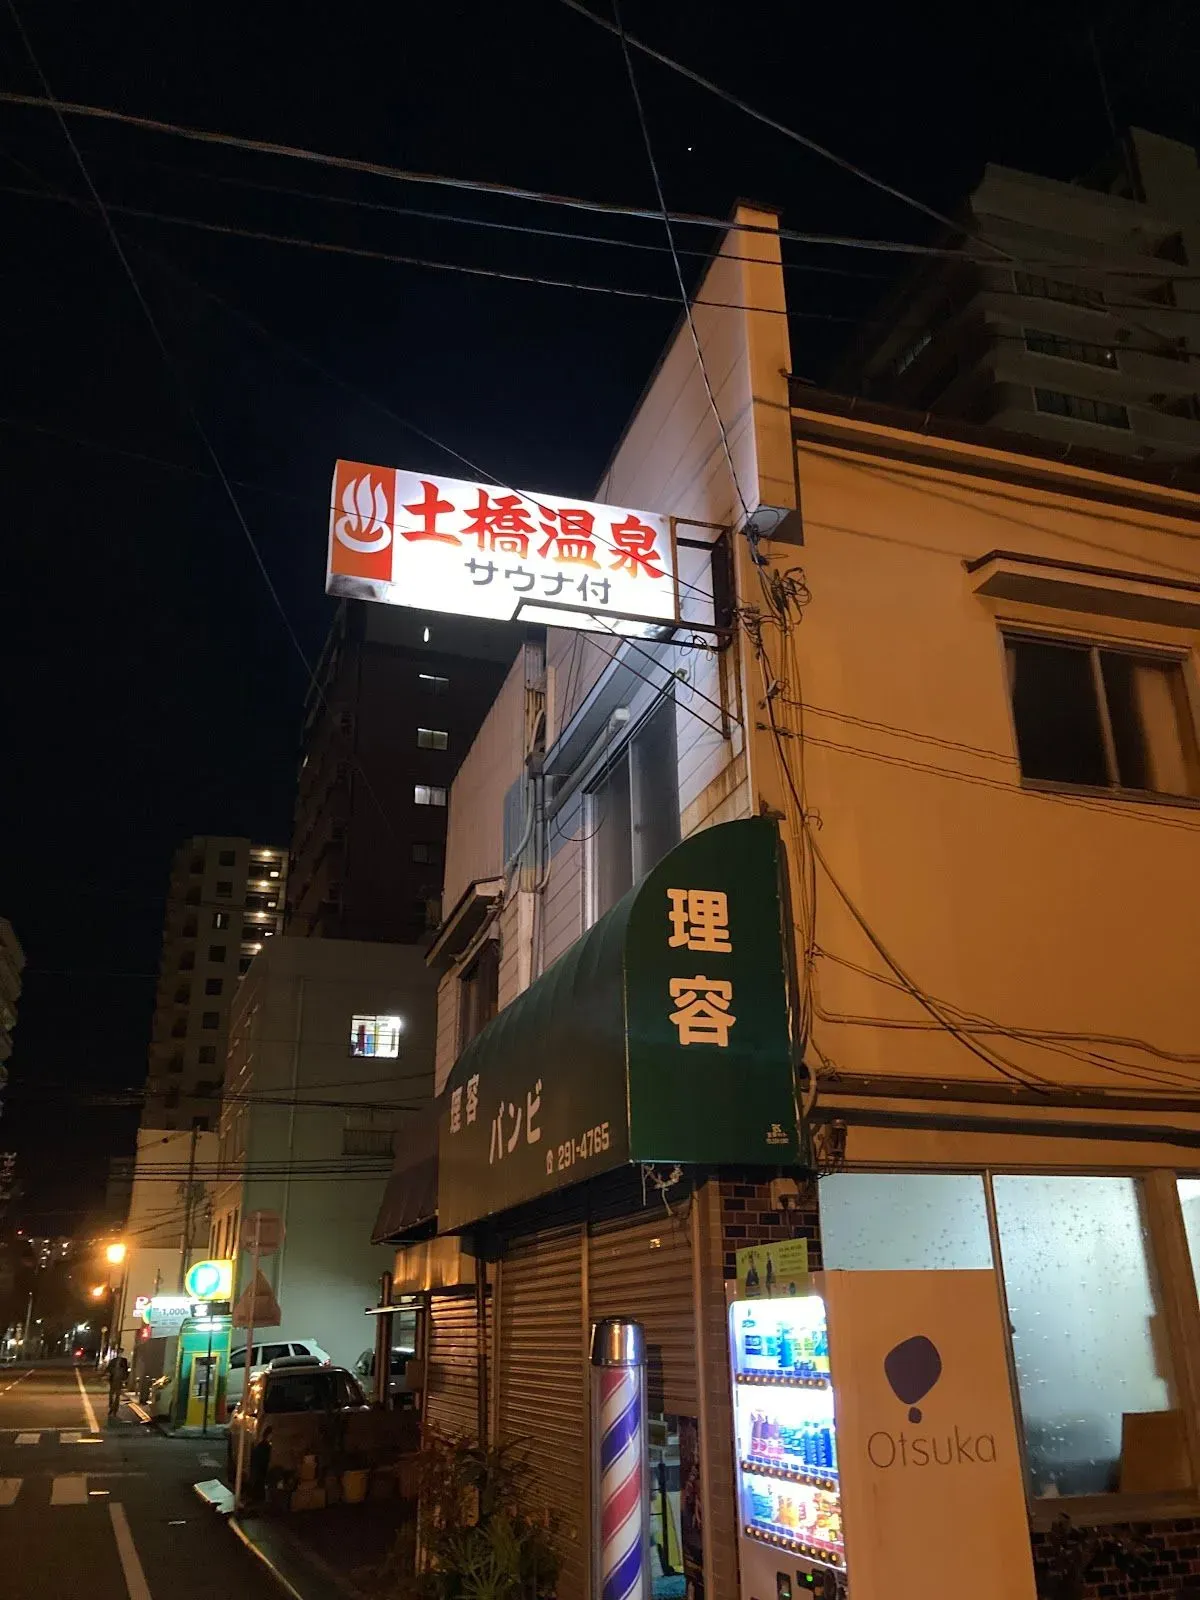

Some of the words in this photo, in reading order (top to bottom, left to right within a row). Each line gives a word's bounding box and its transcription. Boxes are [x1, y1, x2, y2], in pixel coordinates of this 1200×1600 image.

[401, 481, 665, 579] 土橋温泉
[464, 557, 611, 604] サウナ付
[666, 888, 736, 1047] 理容
[450, 1074, 480, 1134] 理容
[489, 1078, 543, 1165] バンビ
[558, 1121, 610, 1171] 291-4765
[867, 1425, 996, 1468] Otsuka
